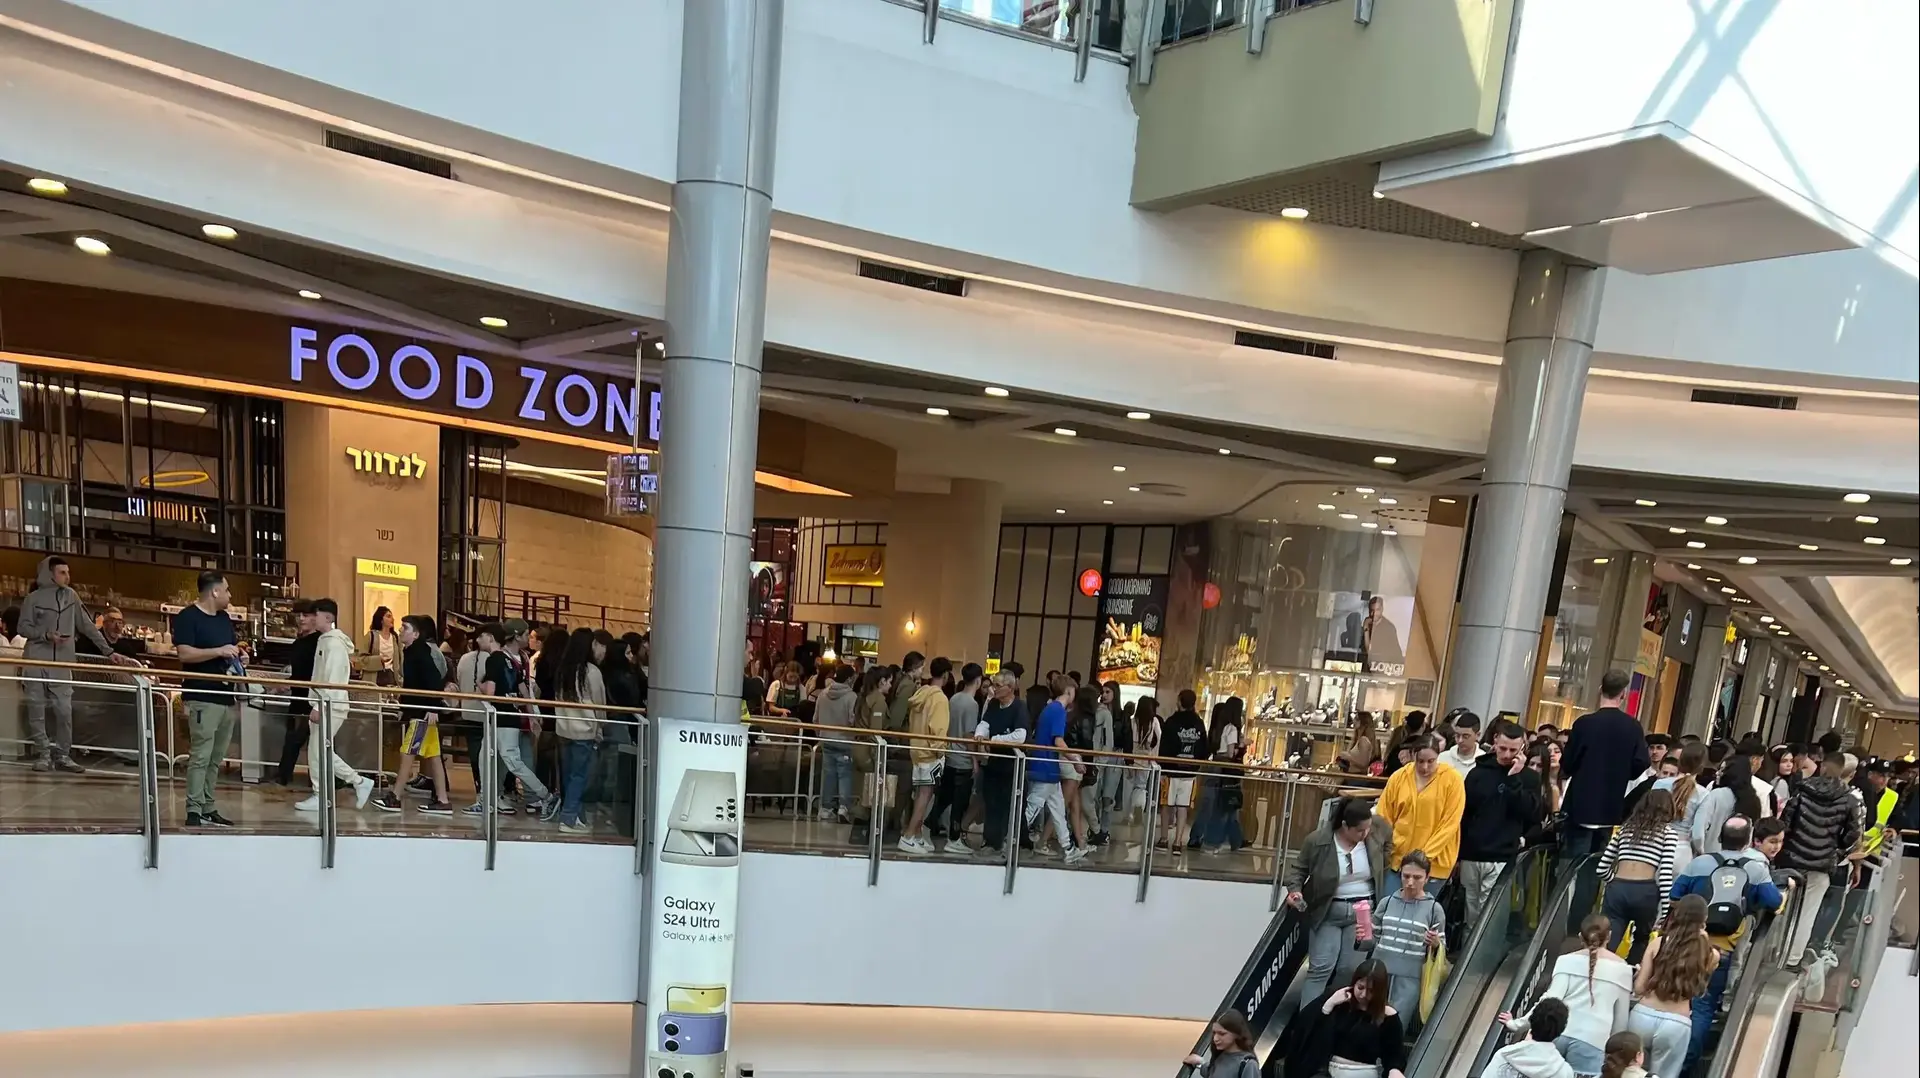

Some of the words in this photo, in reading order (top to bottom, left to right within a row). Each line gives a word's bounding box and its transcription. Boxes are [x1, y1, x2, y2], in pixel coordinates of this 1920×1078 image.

[291, 326, 493, 409] FOOD
[346, 446, 426, 479] לנדוור
[376, 528, 394, 541] כשר
[373, 562, 400, 576] MENU
[679, 730, 742, 748] SAMSUNG
[664, 896, 716, 915] Galaxy
[663, 912, 687, 927] S24
[690, 915, 720, 929] Ultra
[662, 930, 697, 944] Galaxy
[1247, 922, 1300, 1021] SAMSUNG
